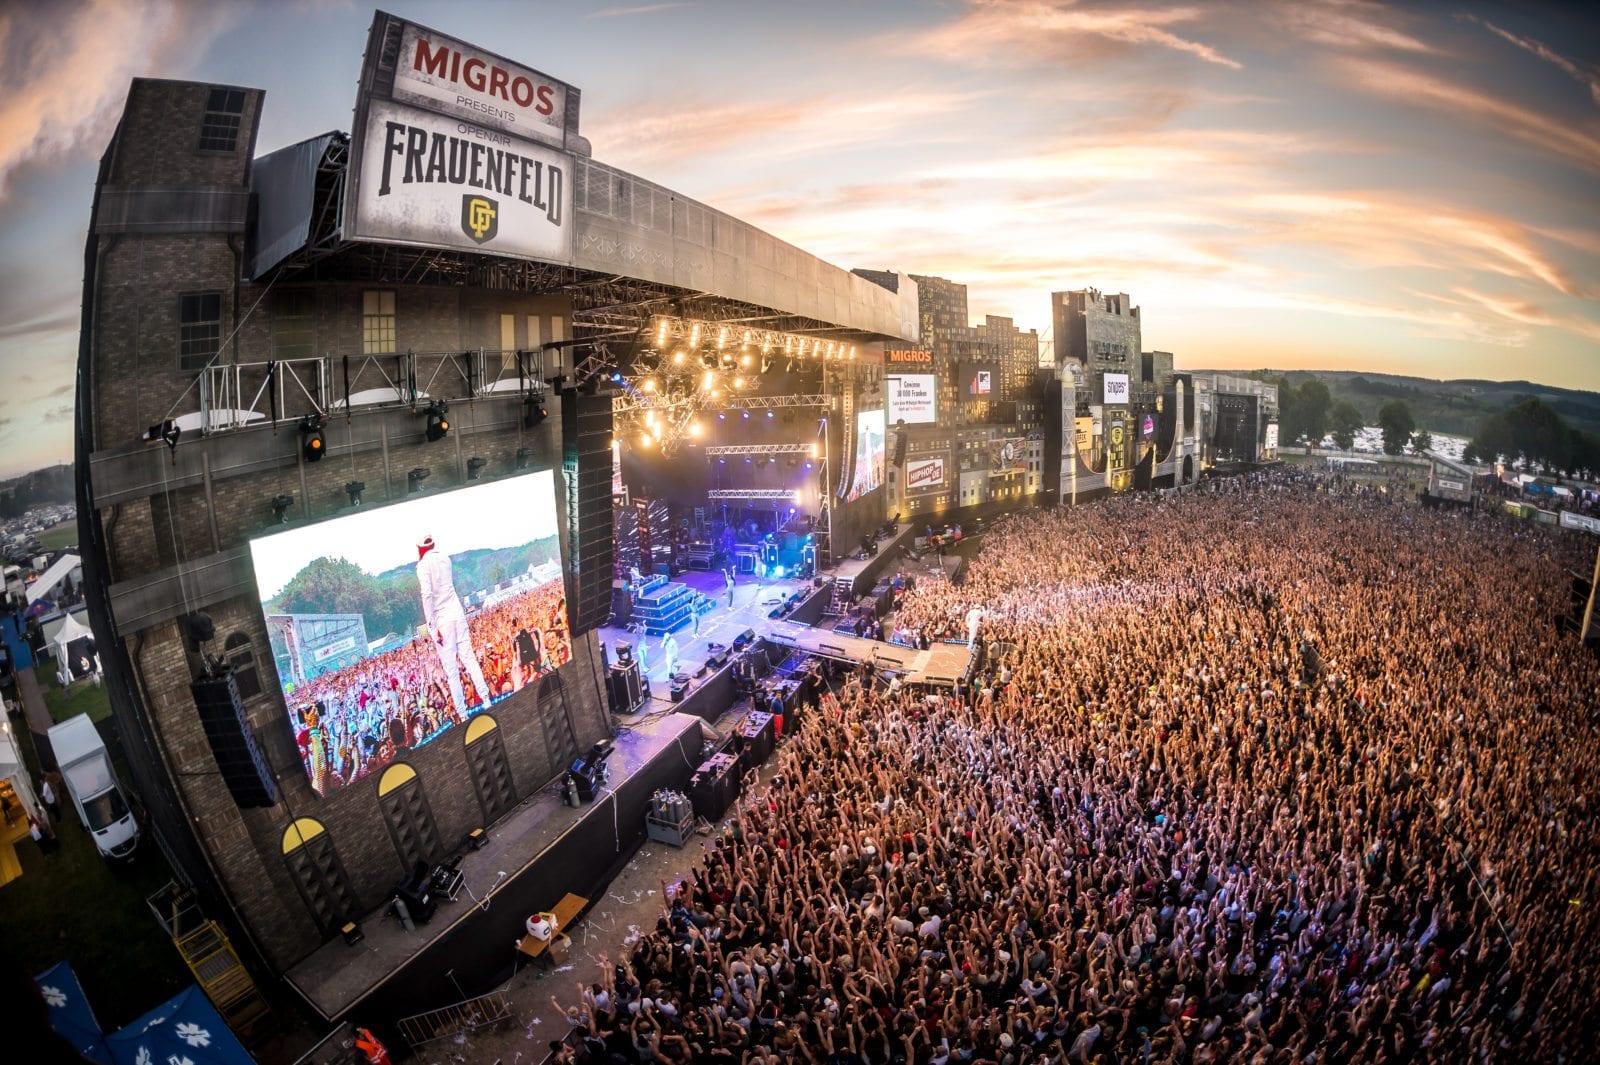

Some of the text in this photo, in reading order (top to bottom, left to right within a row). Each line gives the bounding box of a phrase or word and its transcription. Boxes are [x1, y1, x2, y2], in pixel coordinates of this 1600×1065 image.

[413, 38, 555, 116] MIGROS
[456, 95, 516, 122] PRESENTS
[457, 123, 512, 148] OPENAIR
[378, 120, 563, 227] FRAUENFELD
[890, 350, 932, 362] MIGROS
